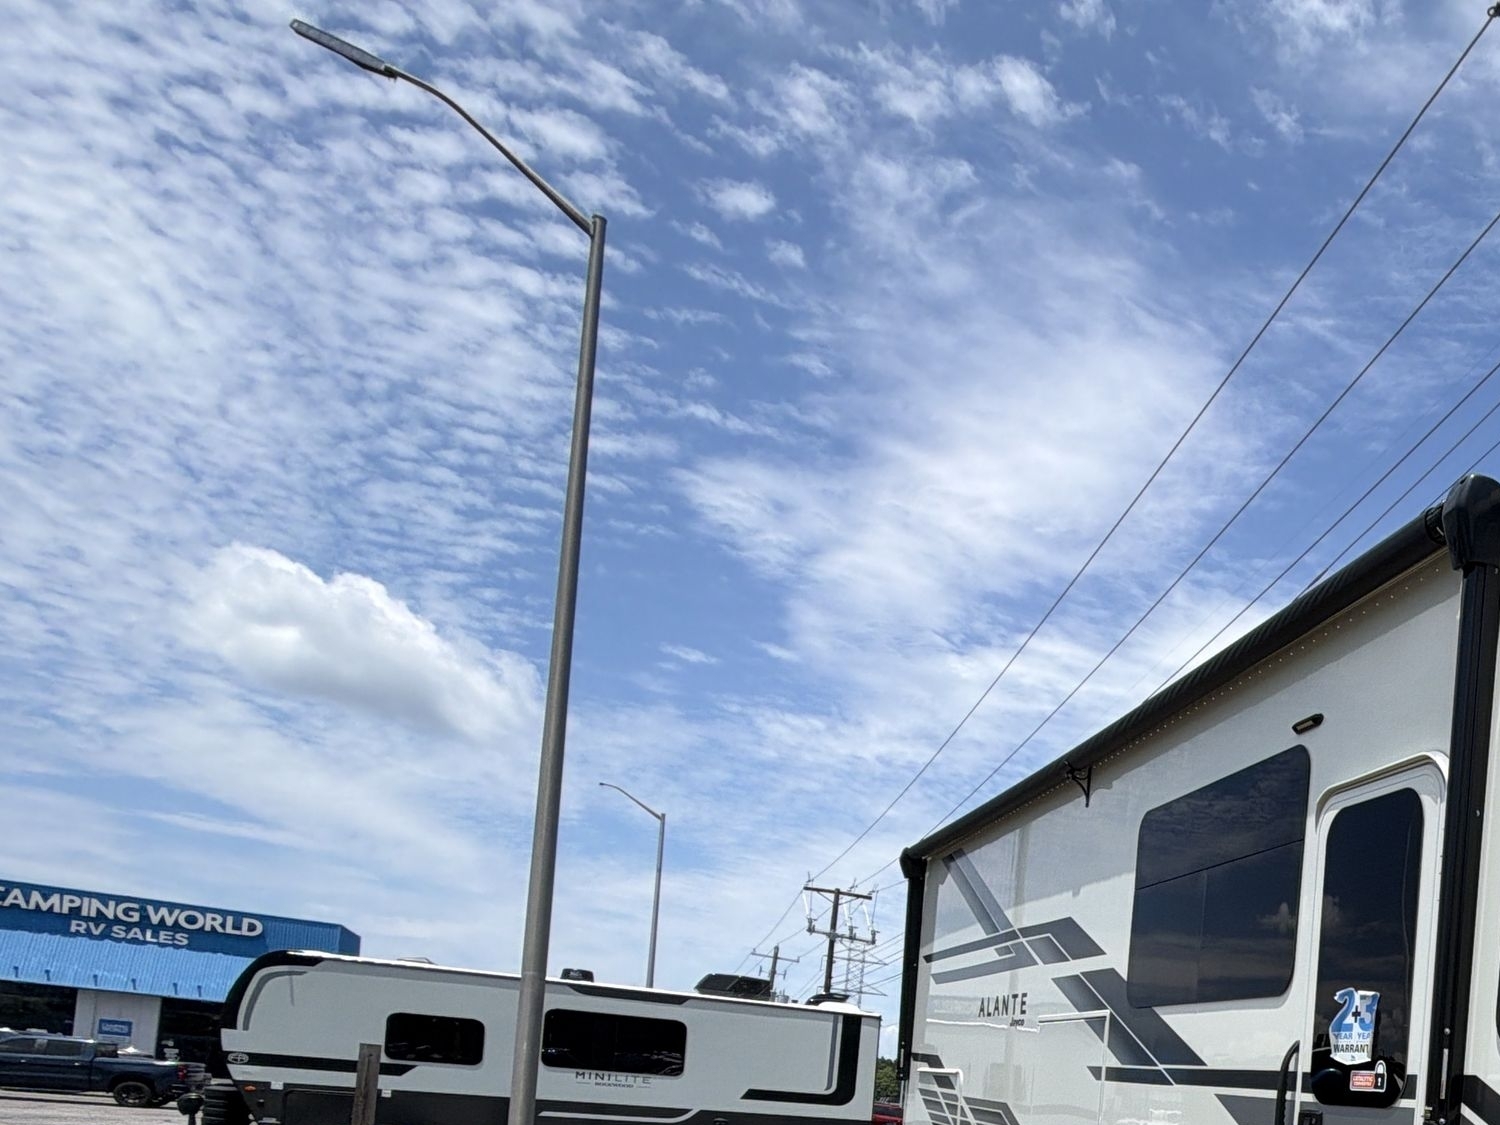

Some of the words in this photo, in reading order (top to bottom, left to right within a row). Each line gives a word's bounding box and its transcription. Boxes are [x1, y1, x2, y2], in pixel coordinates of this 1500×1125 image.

[69, 919, 106, 935] RV
[110, 925, 190, 946] SALES
[147, 904, 264, 937] WORLD
[978, 992, 1028, 1018] ALANTE
[1333, 1043, 1370, 1054] WARRANT
[1357, 1032, 1370, 1040] YEA
